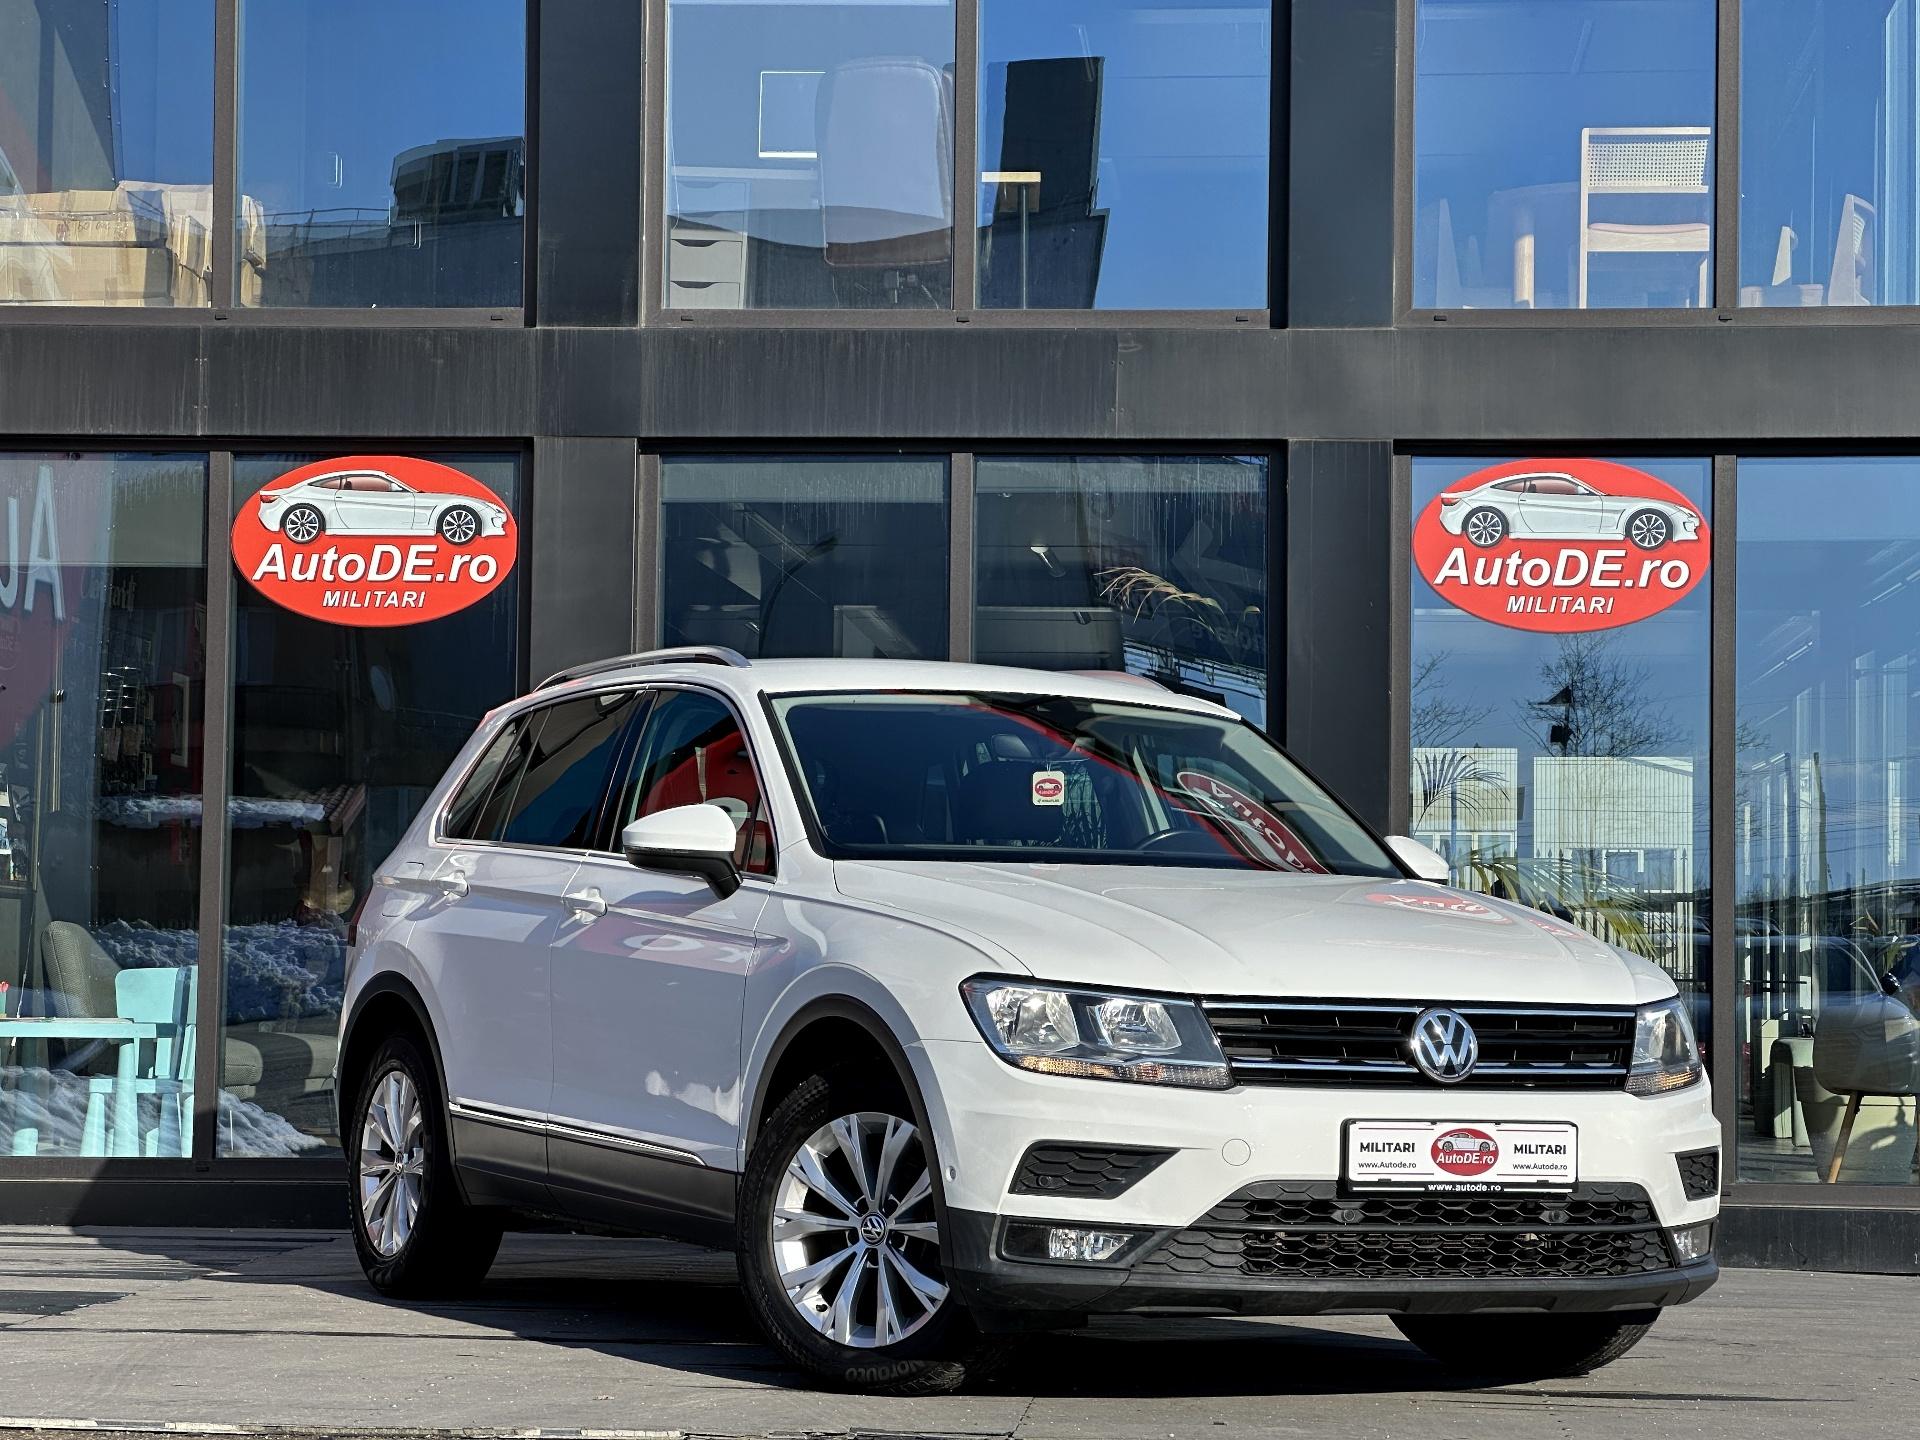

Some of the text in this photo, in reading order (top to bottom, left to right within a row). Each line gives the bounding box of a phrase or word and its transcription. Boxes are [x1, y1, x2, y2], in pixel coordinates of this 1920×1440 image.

[251, 543, 498, 584] AutoDE.ro
[1432, 547, 1691, 589] AutoDE.ro
[322, 590, 426, 608] MILITARI
[1506, 595, 1614, 615] MILITARI
[1416, 1010, 1475, 1079] VW
[1360, 1141, 1416, 1154] MILITARI
[1513, 1143, 1567, 1155] MILITARI
[1436, 1152, 1495, 1165] AutoDE.ro
[1427, 1183, 1502, 1193] www.autode.ro
